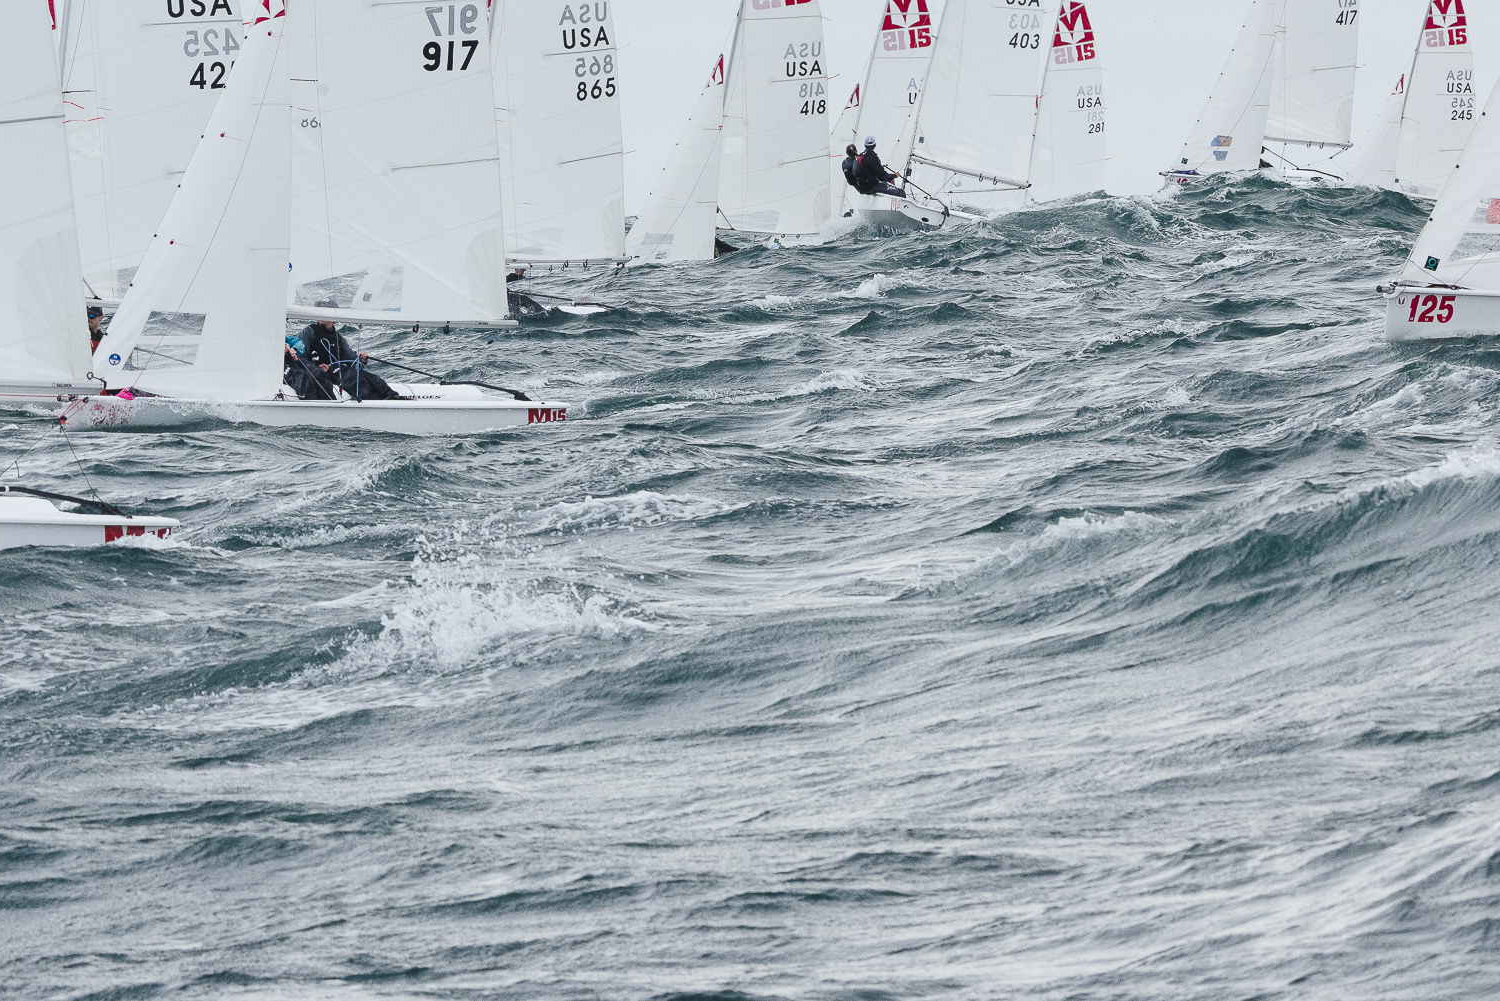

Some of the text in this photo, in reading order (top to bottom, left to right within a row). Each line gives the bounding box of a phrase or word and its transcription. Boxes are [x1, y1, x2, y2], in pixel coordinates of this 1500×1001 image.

[1336, 10, 1357, 26] 417
[563, 26, 609, 48] USA
[909, 28, 931, 49] 15
[1009, 34, 1039, 49] 403
[1448, 28, 1467, 45] 15
[423, 40, 479, 71] 917
[1077, 43, 1095, 61] 15
[190, 61, 235, 89] 42
[786, 60, 822, 77] USA
[577, 77, 616, 101] 865
[800, 100, 826, 115] 418
[1408, 295, 1456, 323] 125
